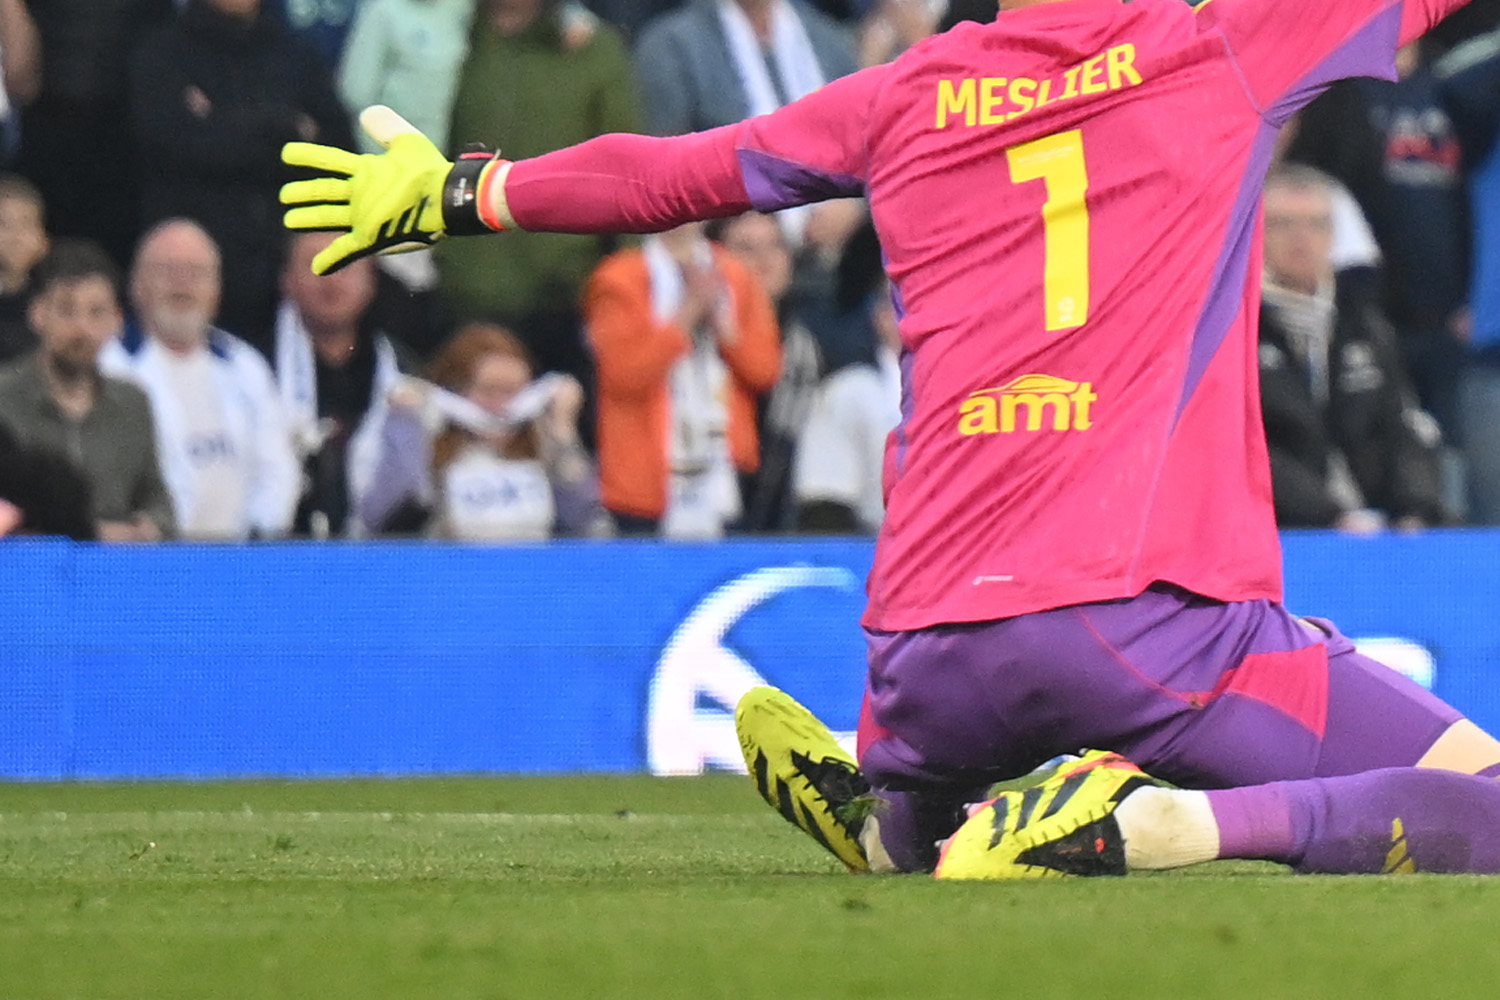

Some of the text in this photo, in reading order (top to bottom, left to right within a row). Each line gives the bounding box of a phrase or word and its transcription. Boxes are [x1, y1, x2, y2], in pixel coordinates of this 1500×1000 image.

[935, 42, 1143, 129] MESLIER
[1006, 128, 1089, 331] 1
[957, 382, 1098, 436] amt
